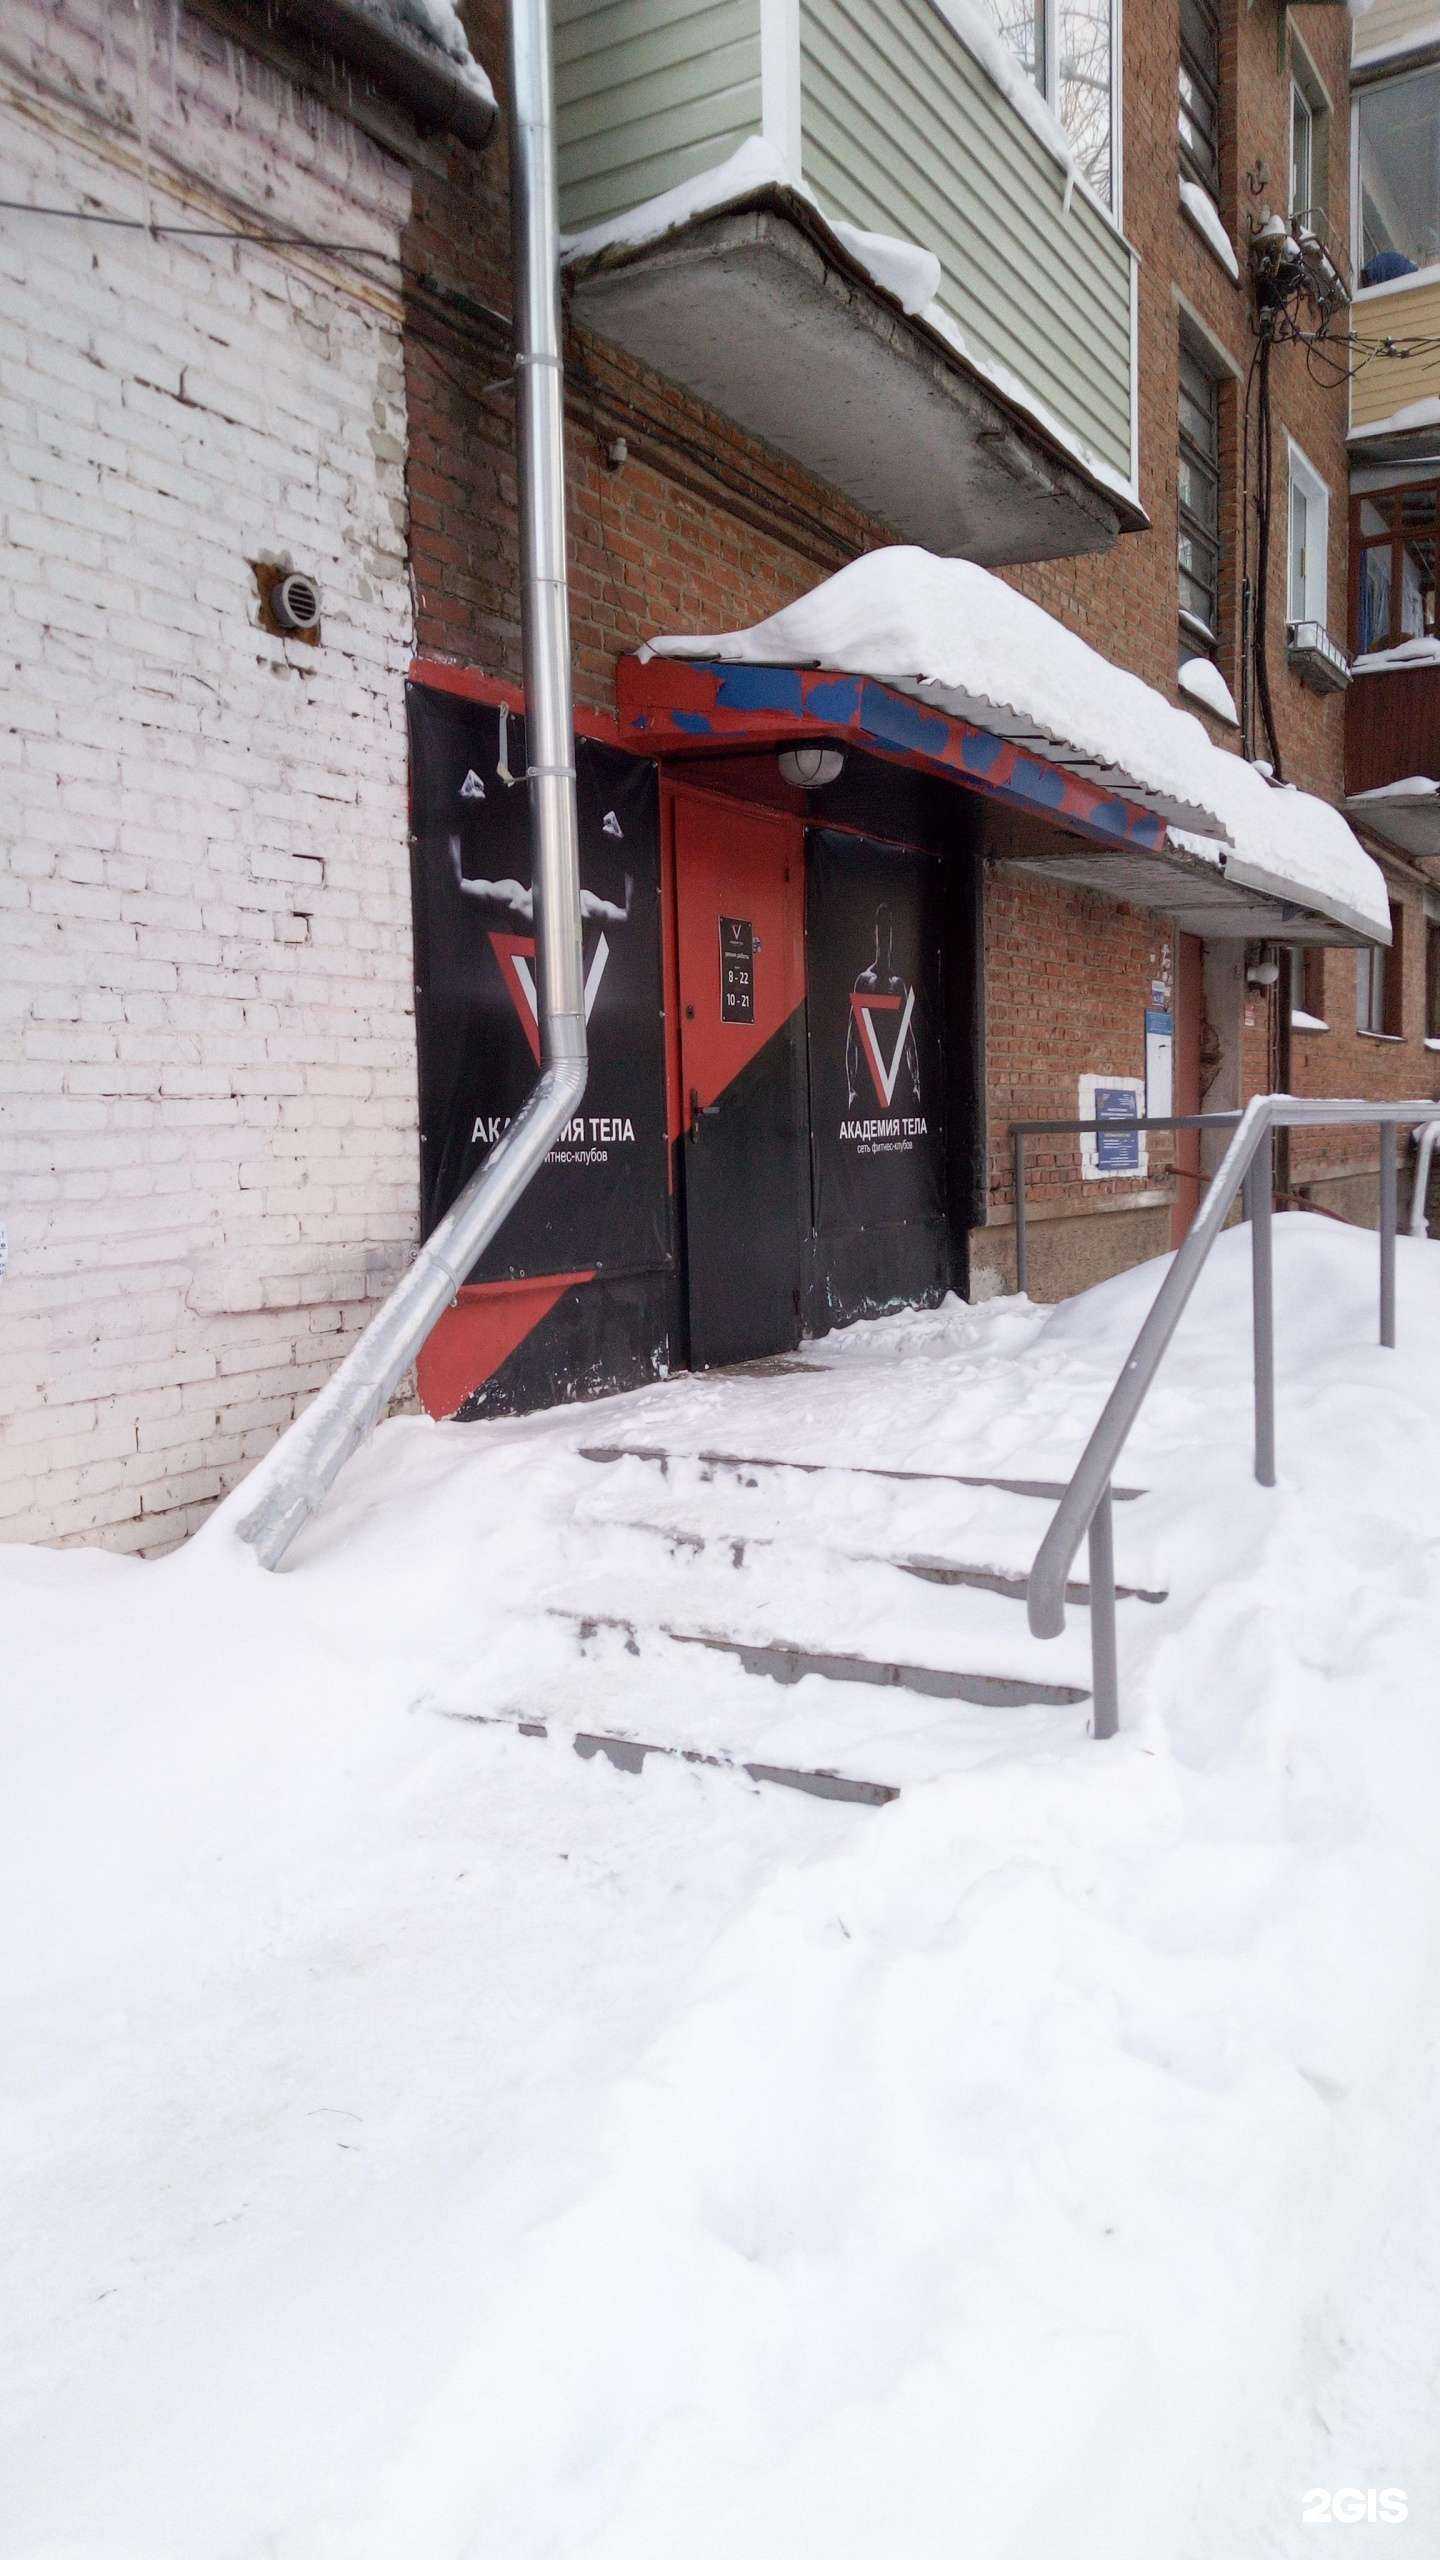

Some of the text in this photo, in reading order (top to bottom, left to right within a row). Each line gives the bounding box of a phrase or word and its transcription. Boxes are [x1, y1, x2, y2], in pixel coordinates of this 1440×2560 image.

[728, 970, 734, 983] 8
[740, 972, 749, 985] 22
[726, 993, 736, 1006] 10
[589, 1118, 636, 1142] ТЕЛА
[839, 1118, 928, 1141] АКАДЕМИЯ ТЕЛА
[857, 1140, 913, 1155] сеть фитнес-клубов
[543, 1148, 608, 1166] итнес-клубов
